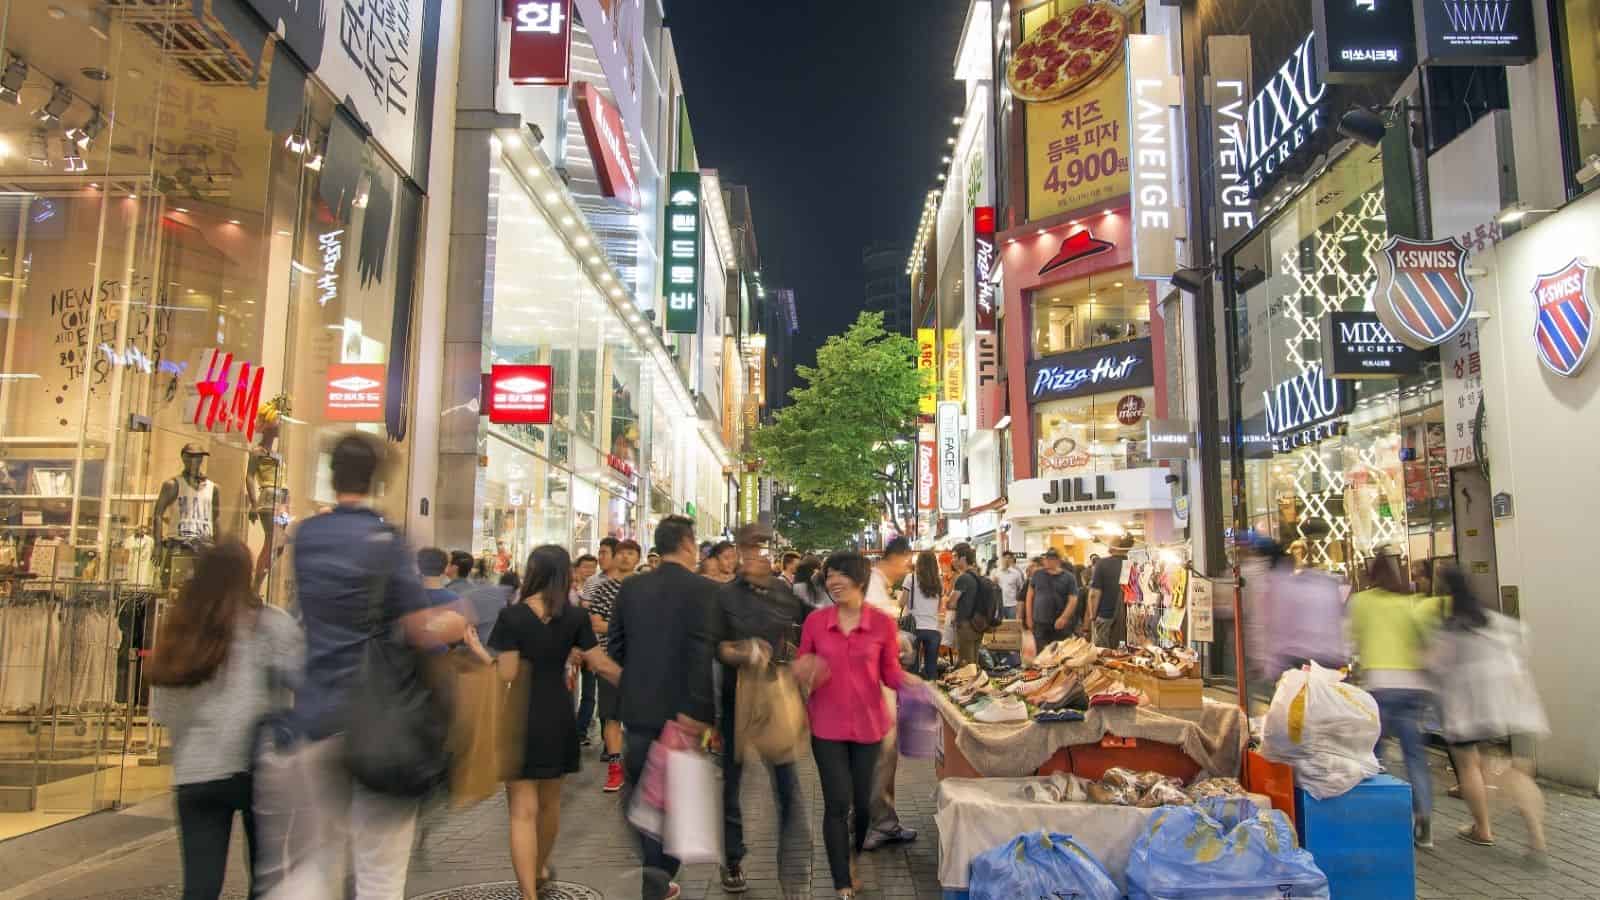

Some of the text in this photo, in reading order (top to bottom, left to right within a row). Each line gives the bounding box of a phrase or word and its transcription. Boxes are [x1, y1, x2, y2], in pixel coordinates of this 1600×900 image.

[1341, 49, 1398, 61] 미쏘시크릿
[1061, 99, 1103, 131] 치즈
[1083, 120, 1119, 147] 피자
[1135, 79, 1168, 229] LANEIGE
[1339, 322, 1402, 343] MIXX
[980, 338, 994, 386] JILL
[1347, 345, 1404, 353] SECRET
[1034, 355, 1139, 396] Pizza Hut
[194, 347, 264, 440] H&M
[1272, 421, 1337, 452] SECRET
[1042, 475, 1115, 504] JILL
